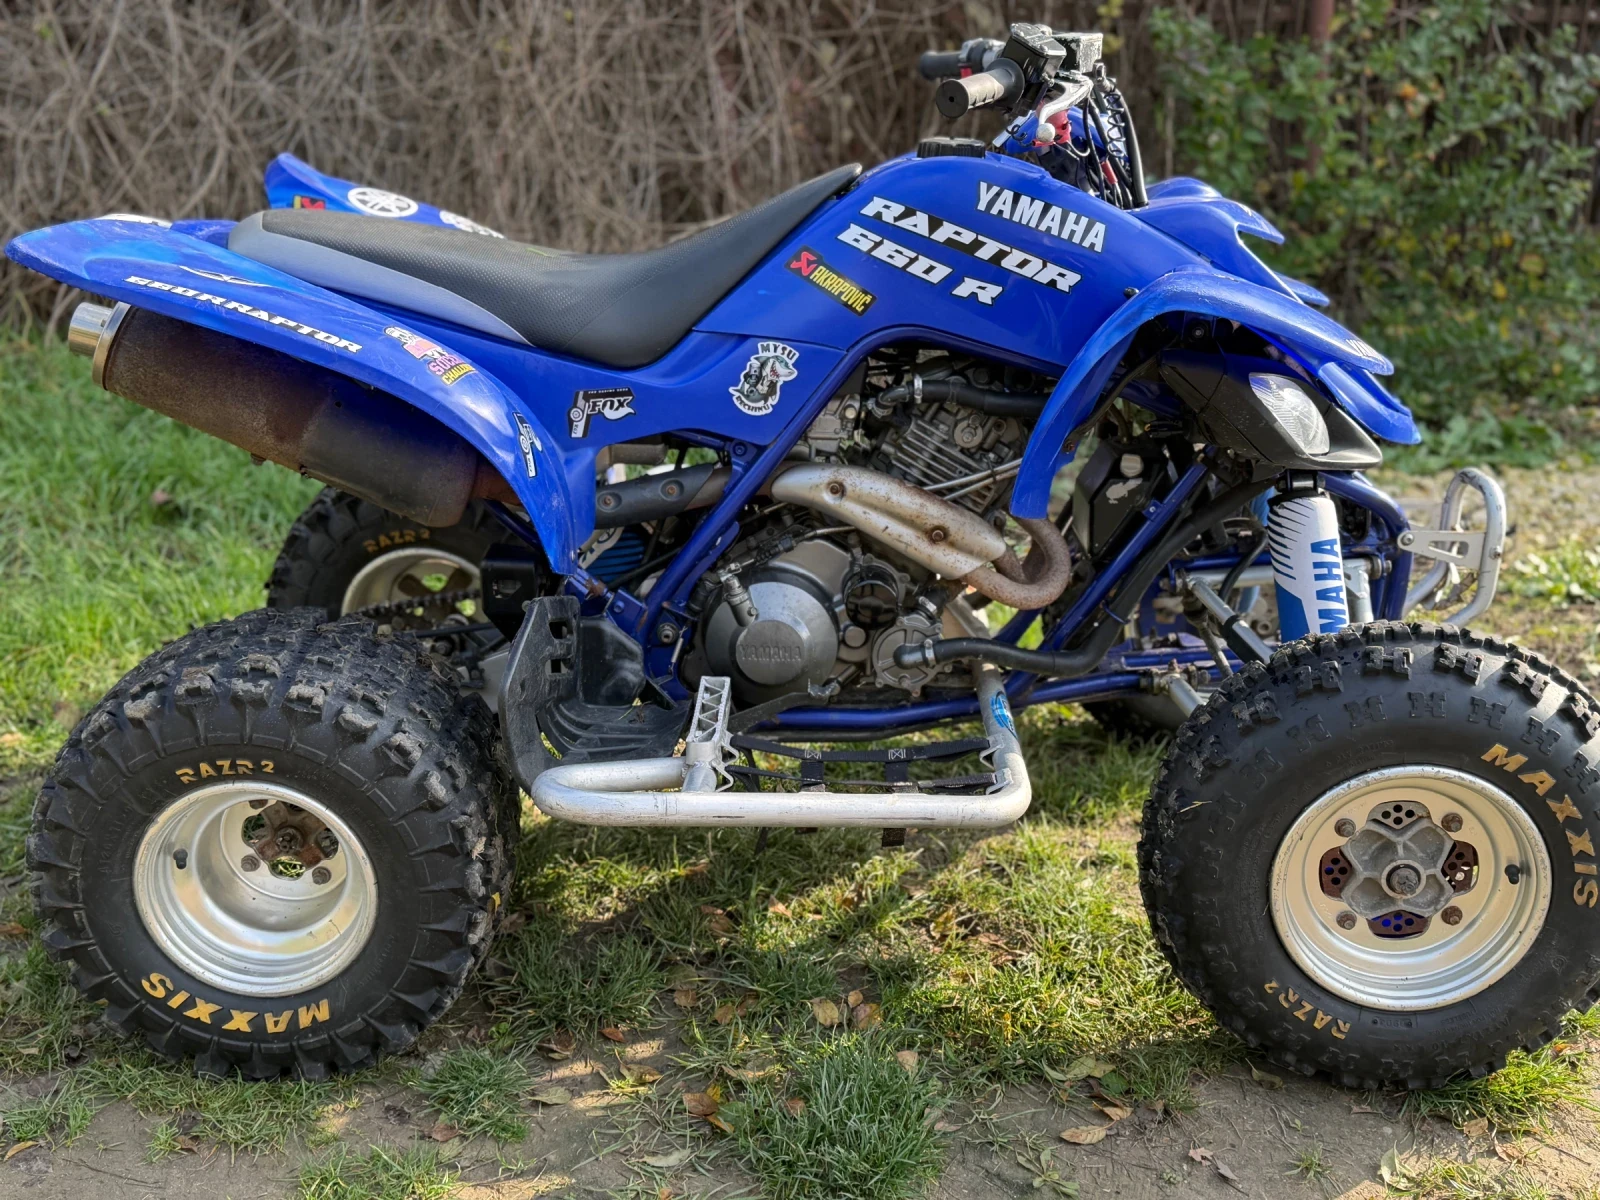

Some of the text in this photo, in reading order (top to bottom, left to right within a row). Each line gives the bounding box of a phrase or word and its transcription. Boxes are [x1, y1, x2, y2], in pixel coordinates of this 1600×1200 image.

[859, 196, 1082, 293] RAPTOR
[976, 181, 1107, 253] YAMAHA
[836, 223, 1003, 305] 660 R
[760, 343, 797, 360] MYSU
[587, 396, 634, 417] FOX
[1310, 538, 1348, 633] MAHA
[738, 644, 802, 661] YAMAHA
[175, 759, 275, 785] RAZR 2
[1480, 743, 1599, 909] MAXXIS
[141, 972, 331, 1034] MAXXIS
[1263, 979, 1351, 1040] RAZR 2
